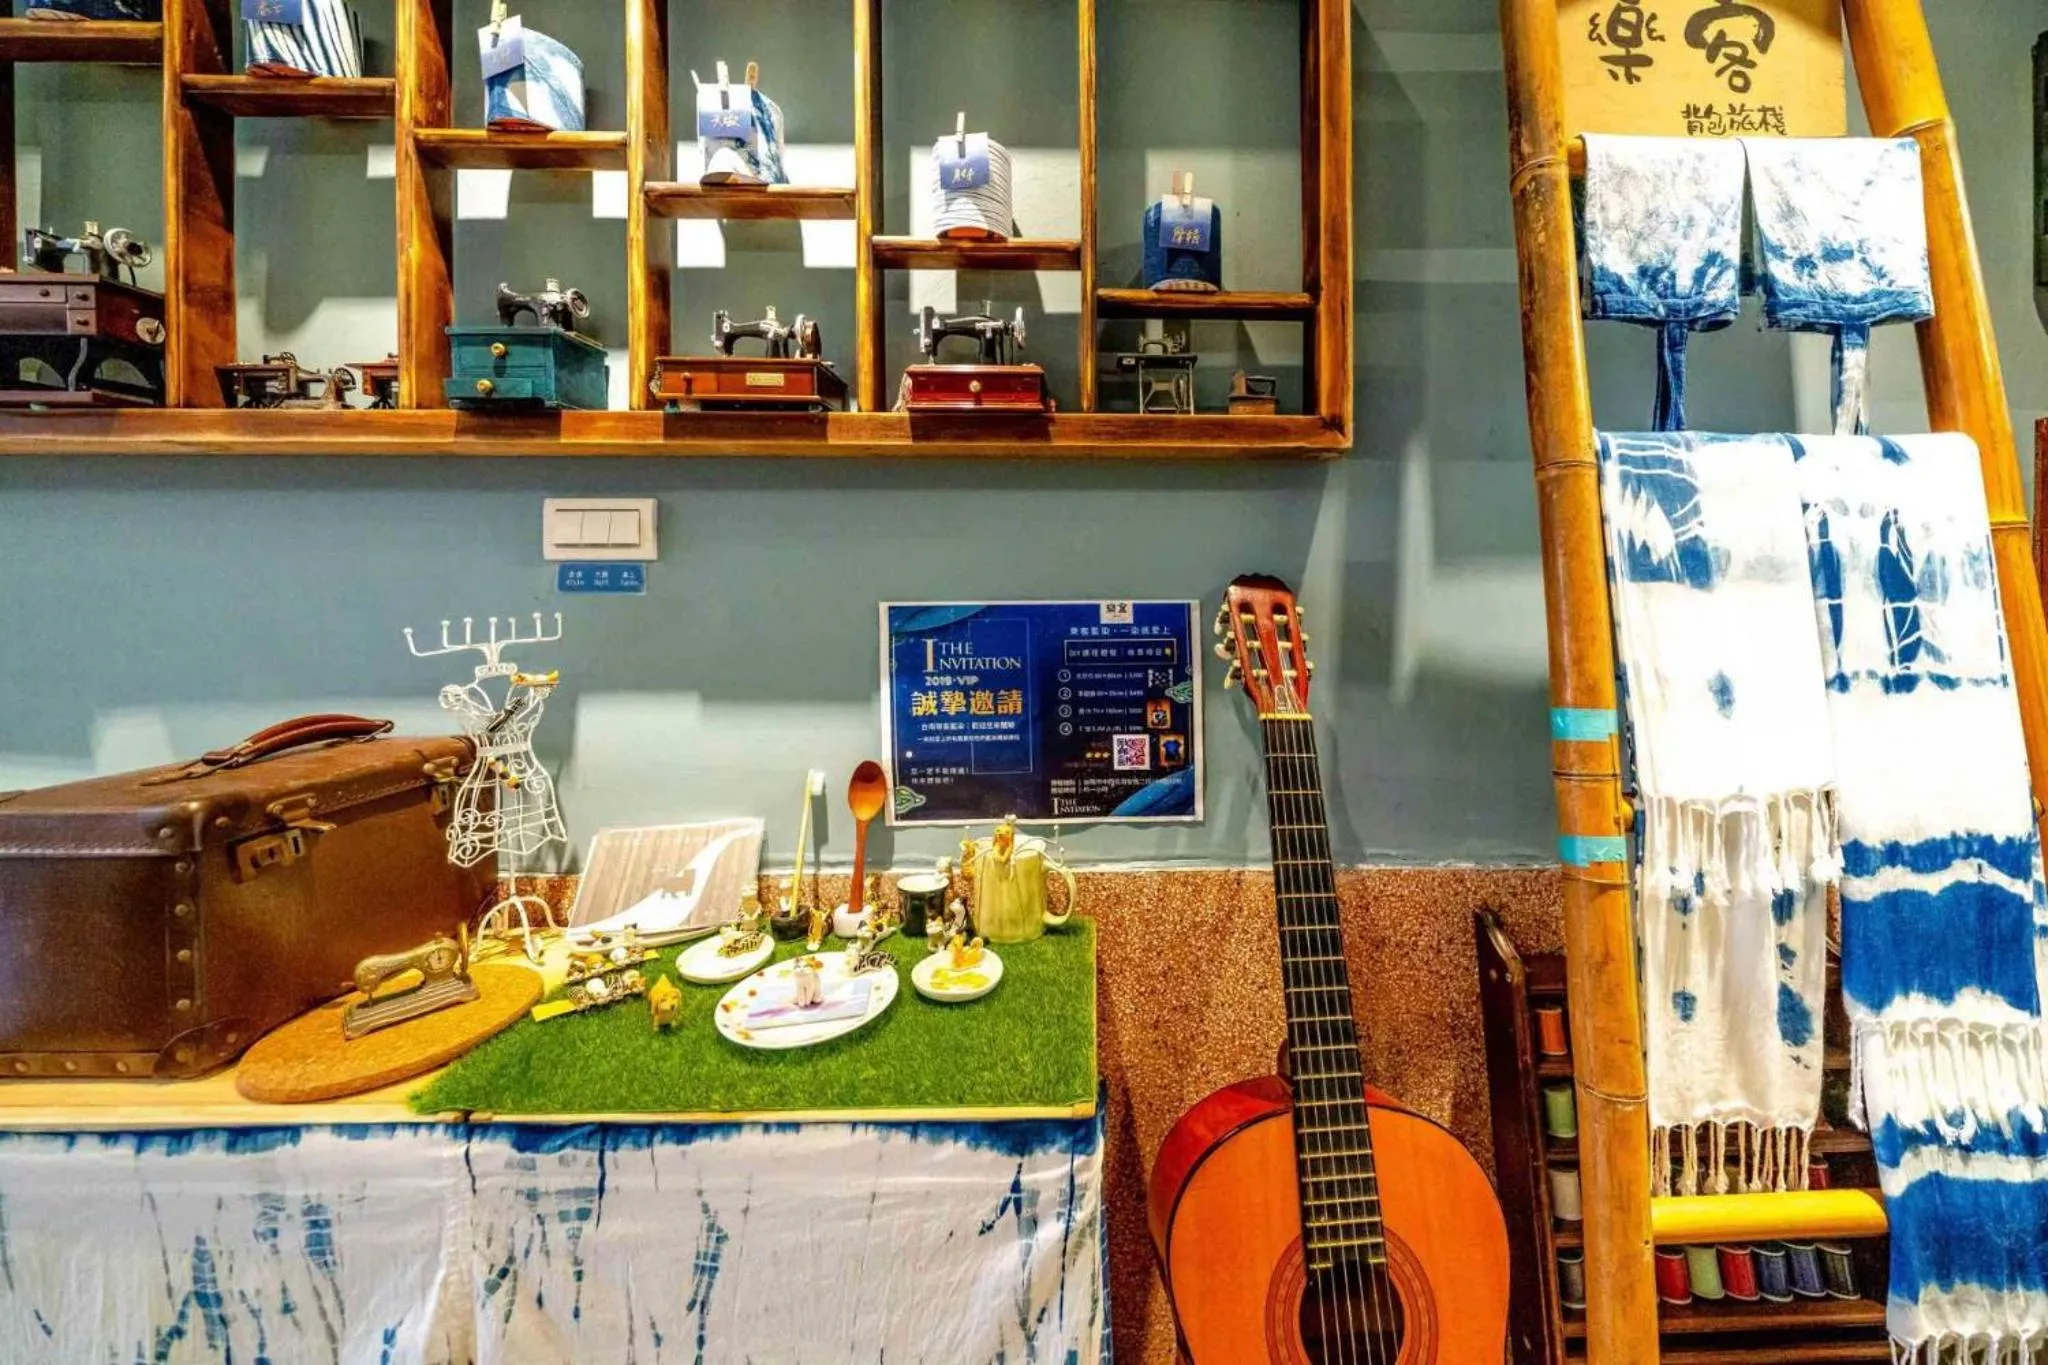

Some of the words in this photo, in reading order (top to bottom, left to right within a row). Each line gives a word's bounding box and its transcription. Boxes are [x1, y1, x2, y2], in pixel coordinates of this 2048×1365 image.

[938, 642, 974, 655] THE
[910, 688, 1023, 717] 誠摯邀請
